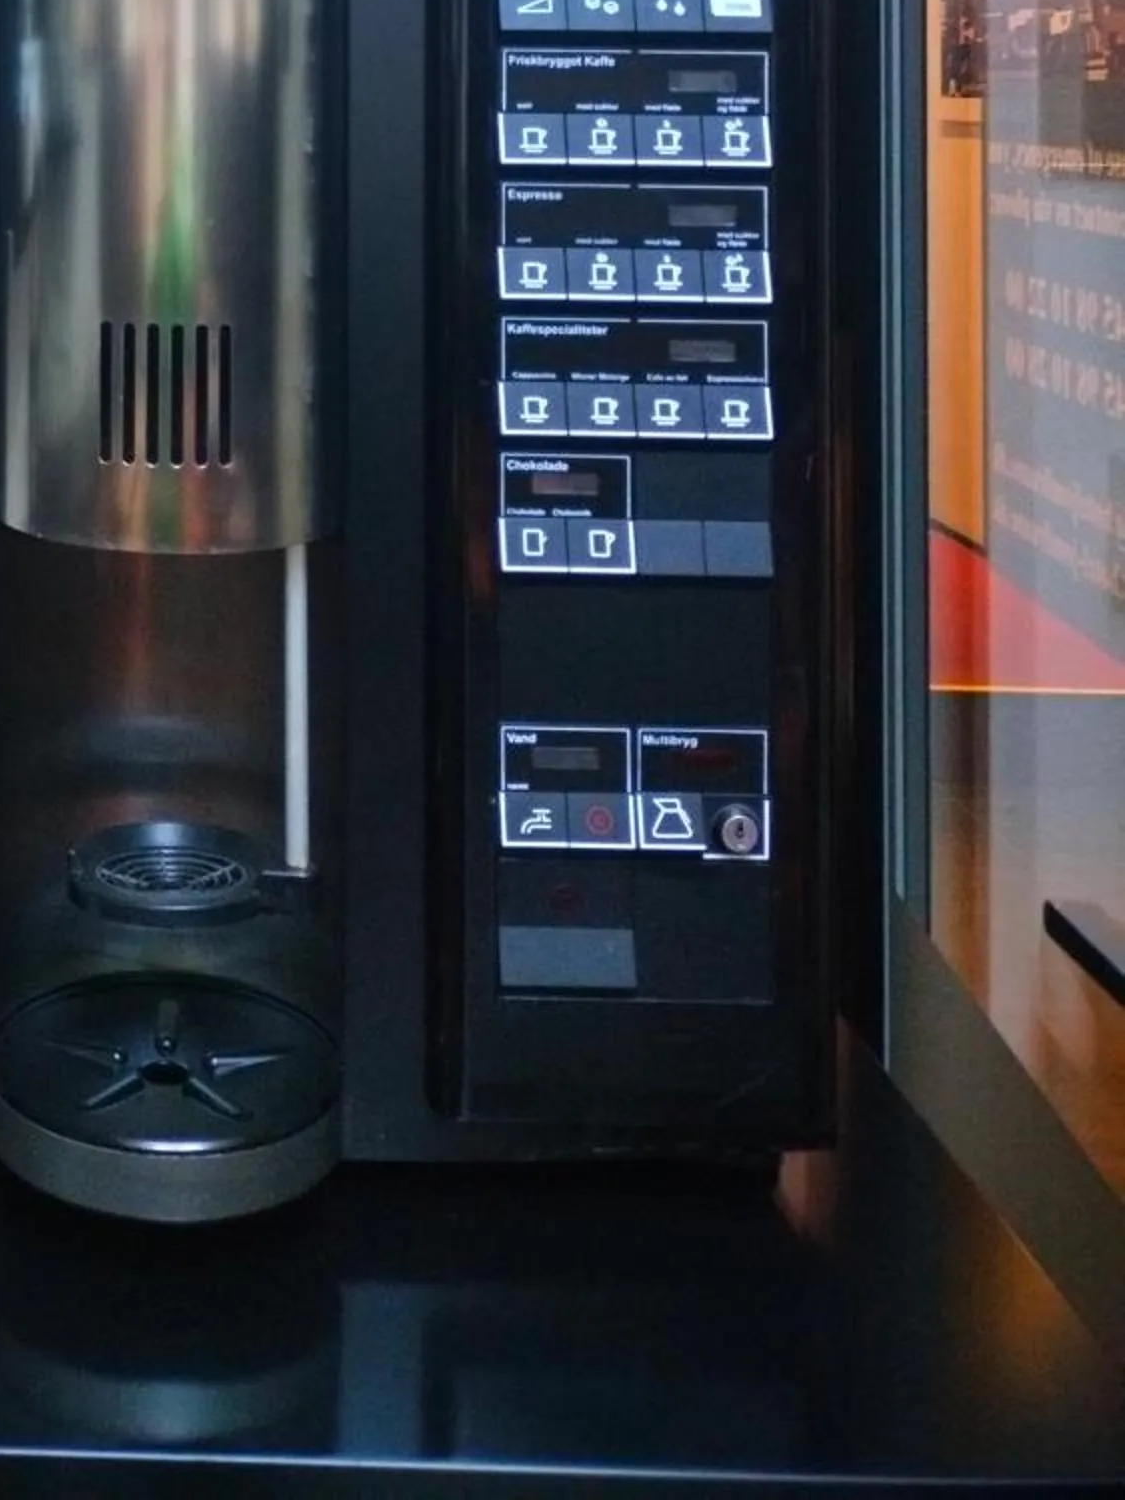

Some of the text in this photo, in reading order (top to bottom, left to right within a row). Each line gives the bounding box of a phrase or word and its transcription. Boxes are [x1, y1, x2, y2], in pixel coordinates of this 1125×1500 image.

[584, 56, 615, 67] Kaffe
[508, 188, 563, 201] Espresso
[507, 323, 608, 337] Kaffespecialiteter
[506, 460, 569, 472] Chokolade
[507, 733, 537, 744] Vand
[642, 734, 698, 749] Multibryg
